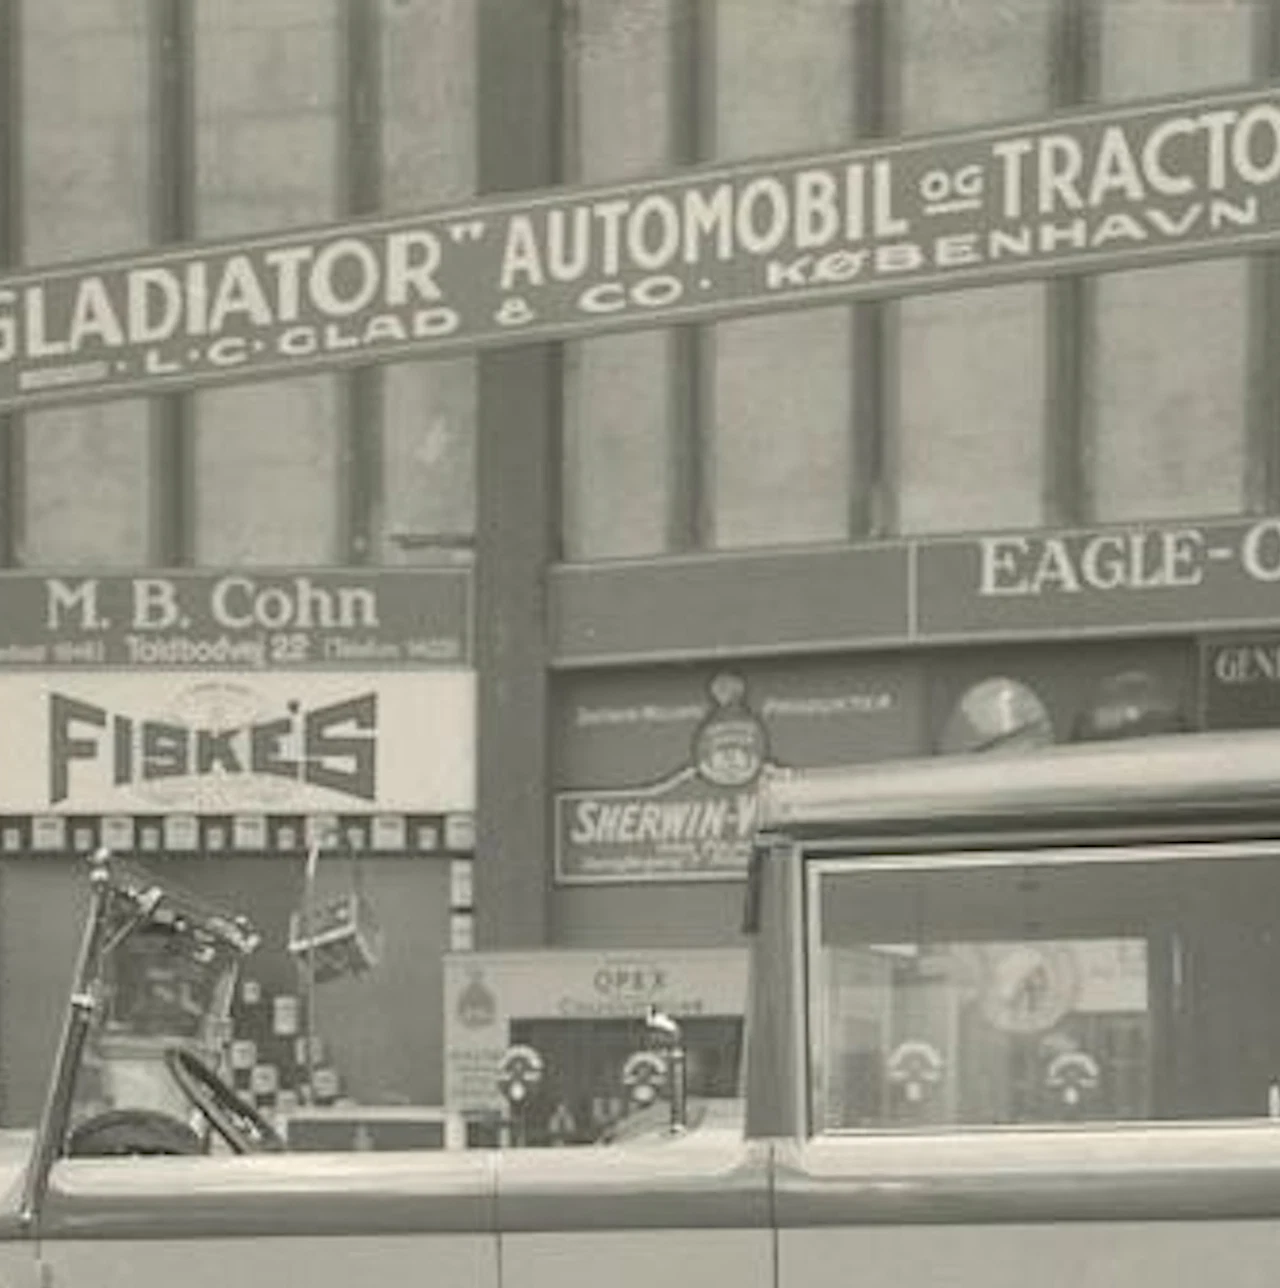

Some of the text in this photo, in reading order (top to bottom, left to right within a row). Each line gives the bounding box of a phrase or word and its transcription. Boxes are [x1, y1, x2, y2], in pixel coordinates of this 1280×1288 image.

[278, 307, 460, 354] GLAD
[494, 298, 534, 325] &
[766, 196, 1259, 290] KØBENHAVN
[500, 160, 909, 290] AUTOMOBIL
[45, 576, 380, 630] M. B. Cohn
[47, 692, 378, 805] FISKE'S
